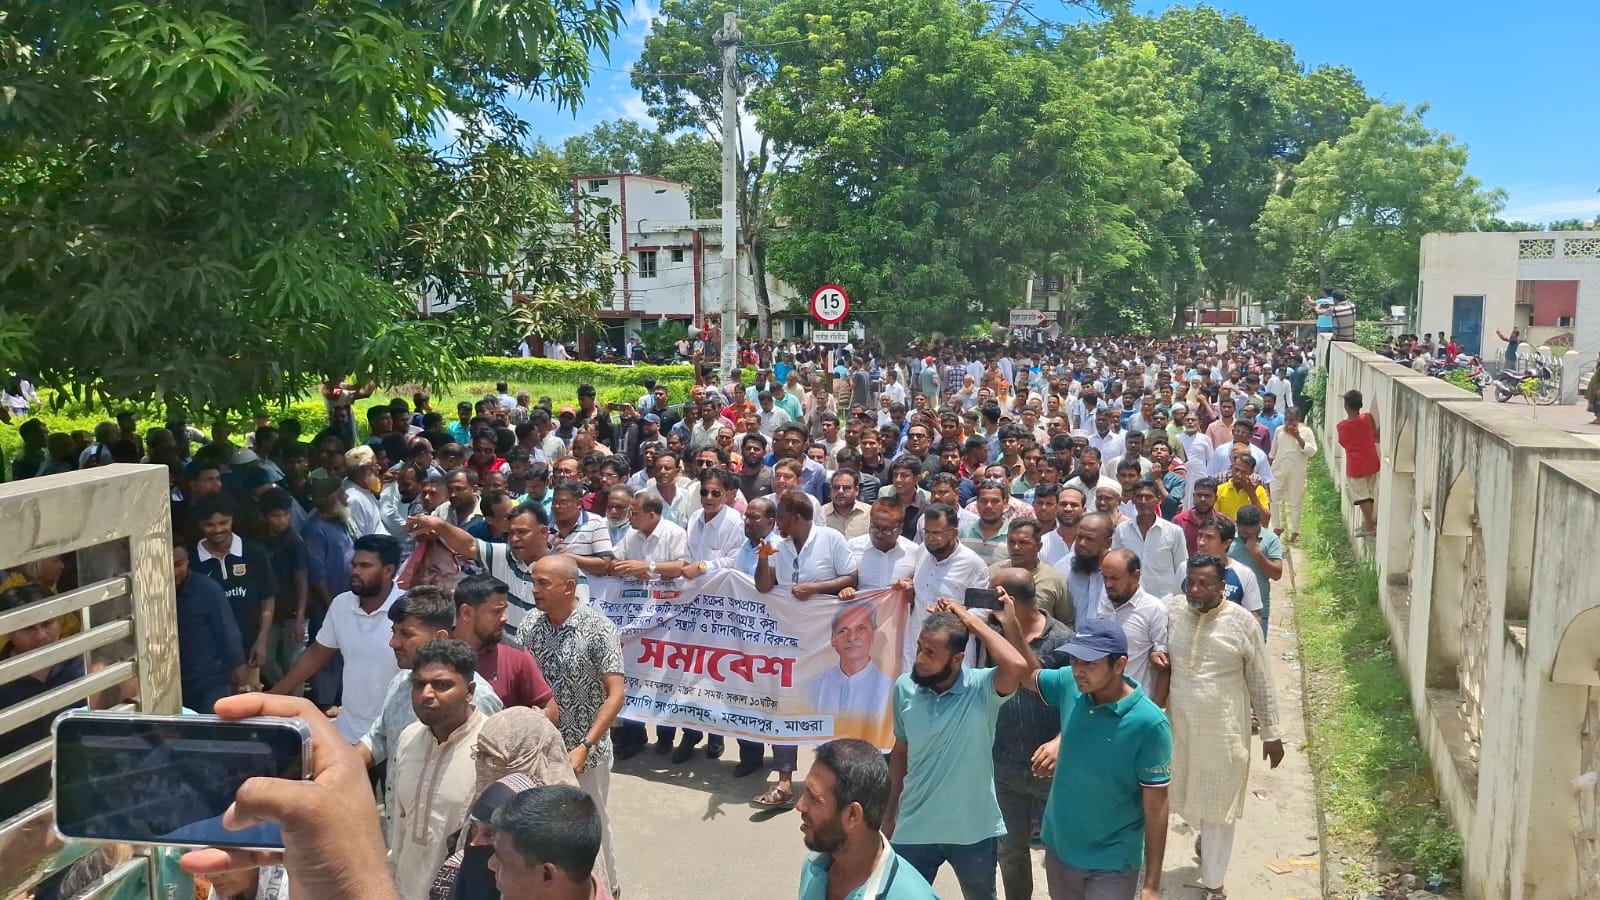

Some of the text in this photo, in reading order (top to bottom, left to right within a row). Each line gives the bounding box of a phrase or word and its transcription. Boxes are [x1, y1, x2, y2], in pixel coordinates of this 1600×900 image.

[820, 293, 840, 309] 15
[225, 586, 246, 597] otify
[1224, 583, 1238, 592] UST
[760, 617, 778, 631] করা
[700, 622, 708, 632] ও
[763, 630, 800, 648] বিরুদ্ধে
[637, 637, 797, 688] সমাবেশ
[726, 692, 748, 705] সকাল
[784, 720, 824, 732] মাগুরা
